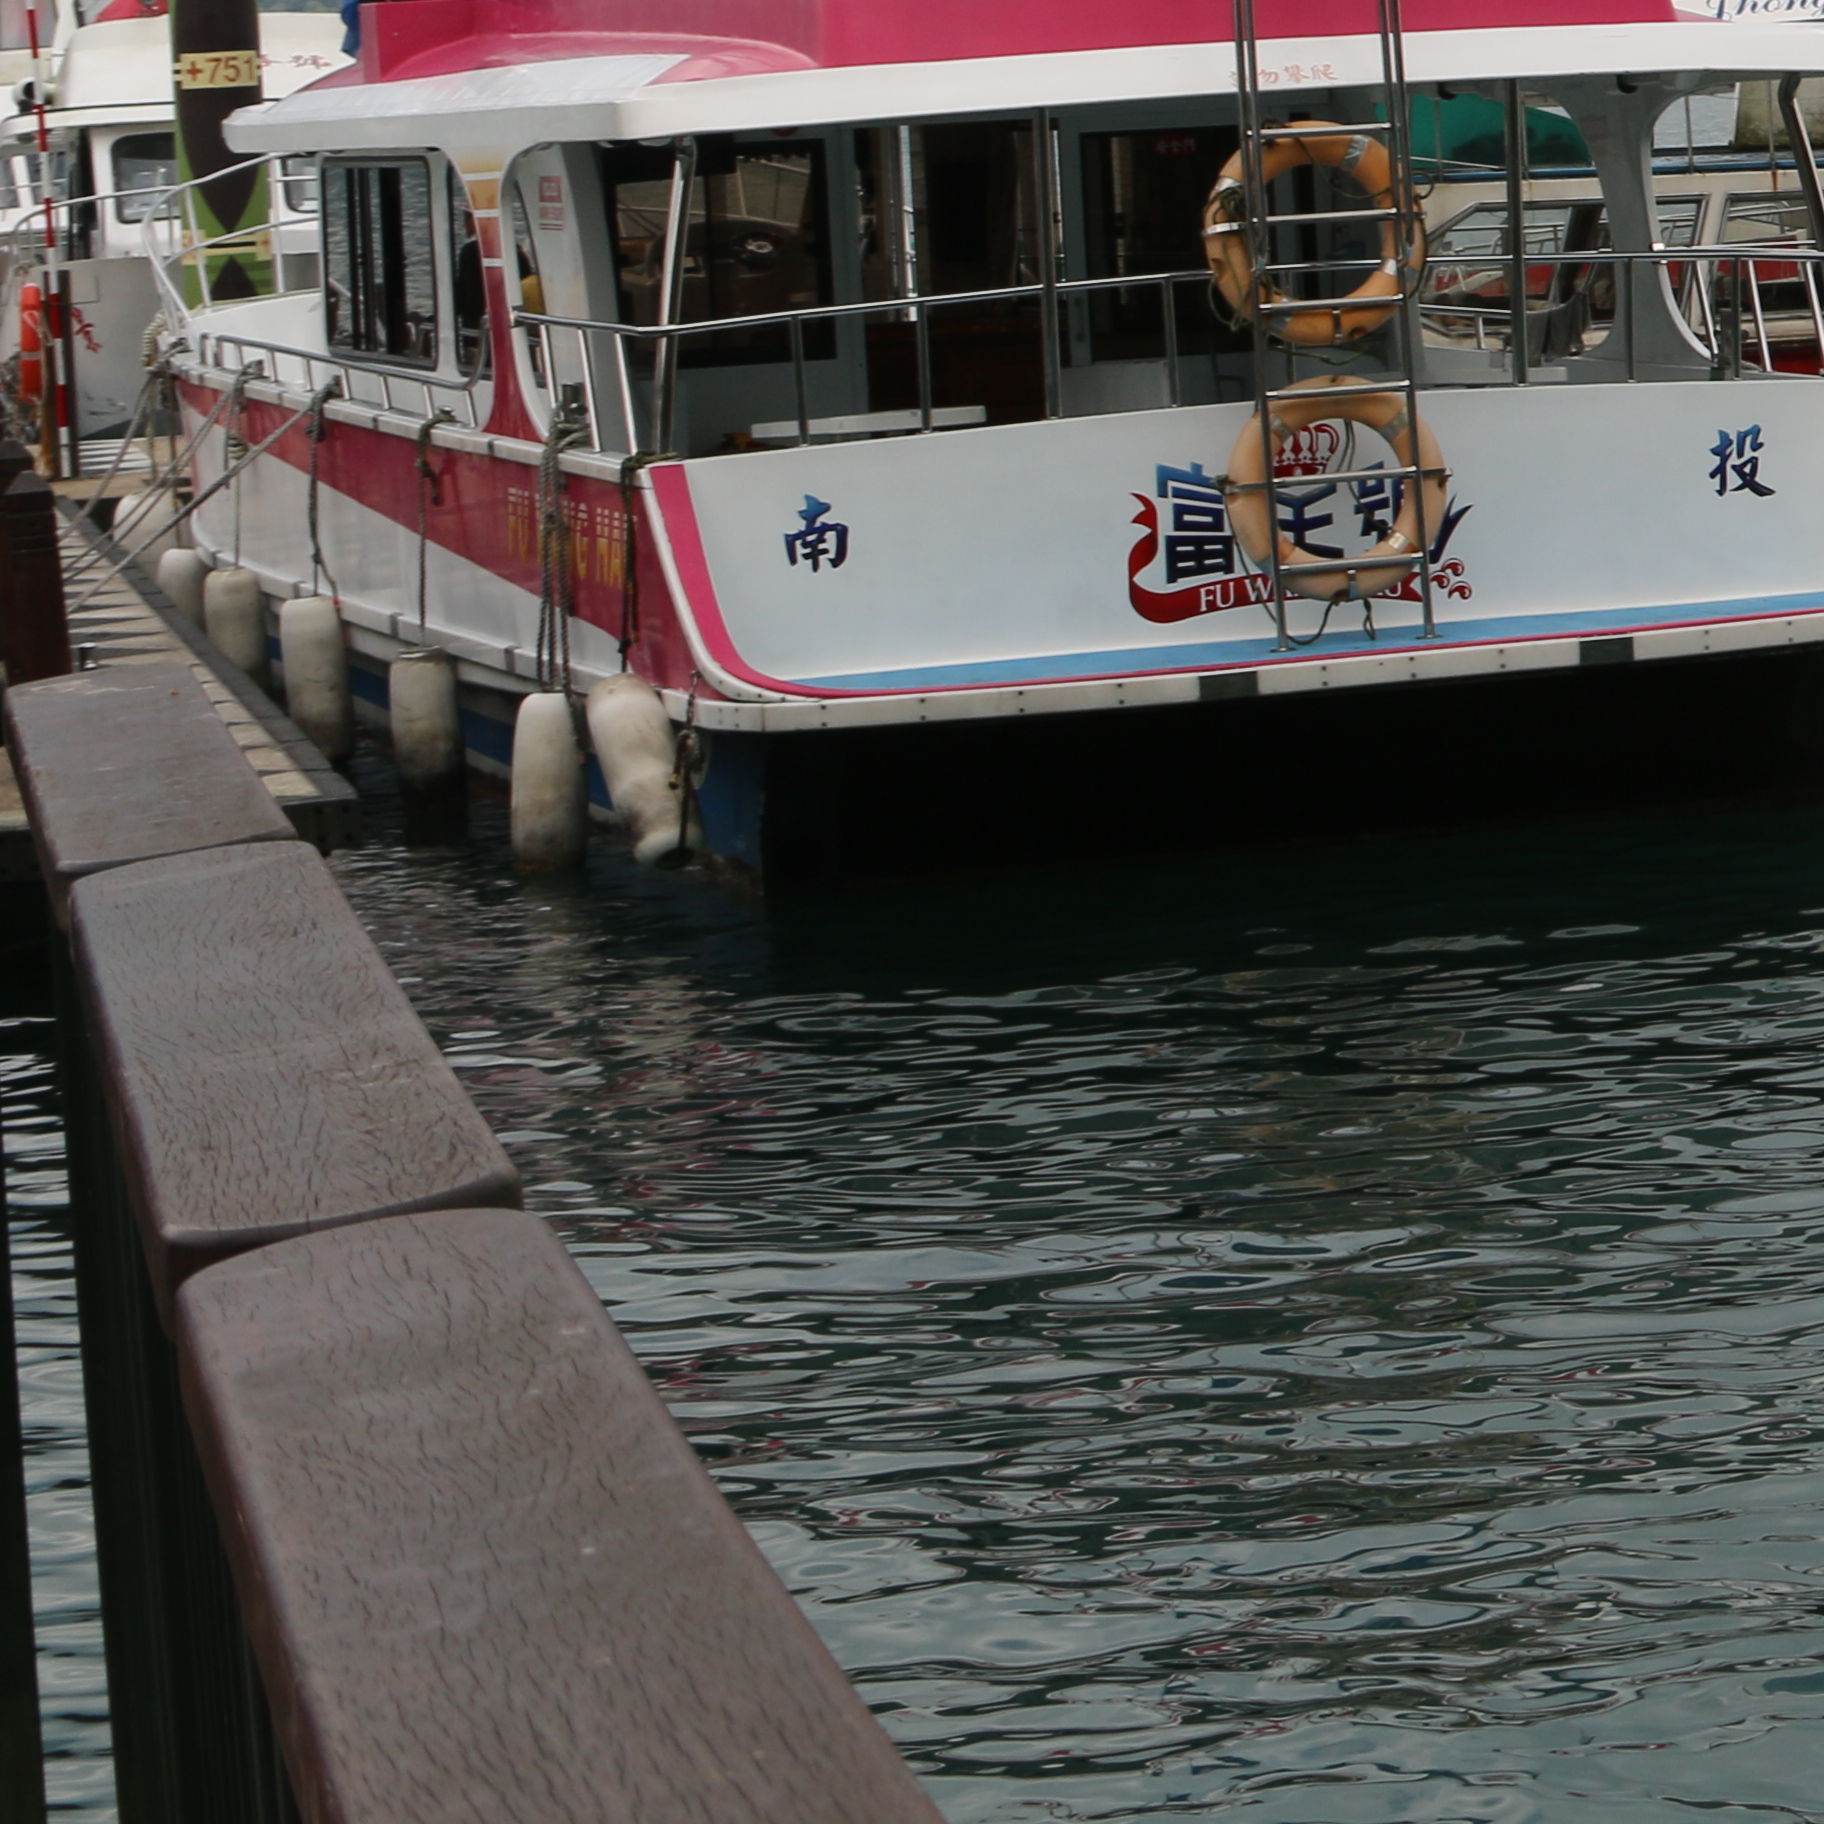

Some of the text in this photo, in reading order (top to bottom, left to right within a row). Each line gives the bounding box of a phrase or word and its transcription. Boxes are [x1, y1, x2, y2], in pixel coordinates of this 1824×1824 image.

[187, 56, 256, 84] +751
[1709, 423, 1776, 497] 投
[784, 493, 848, 573] 南
[1200, 581, 1236, 612] FU
